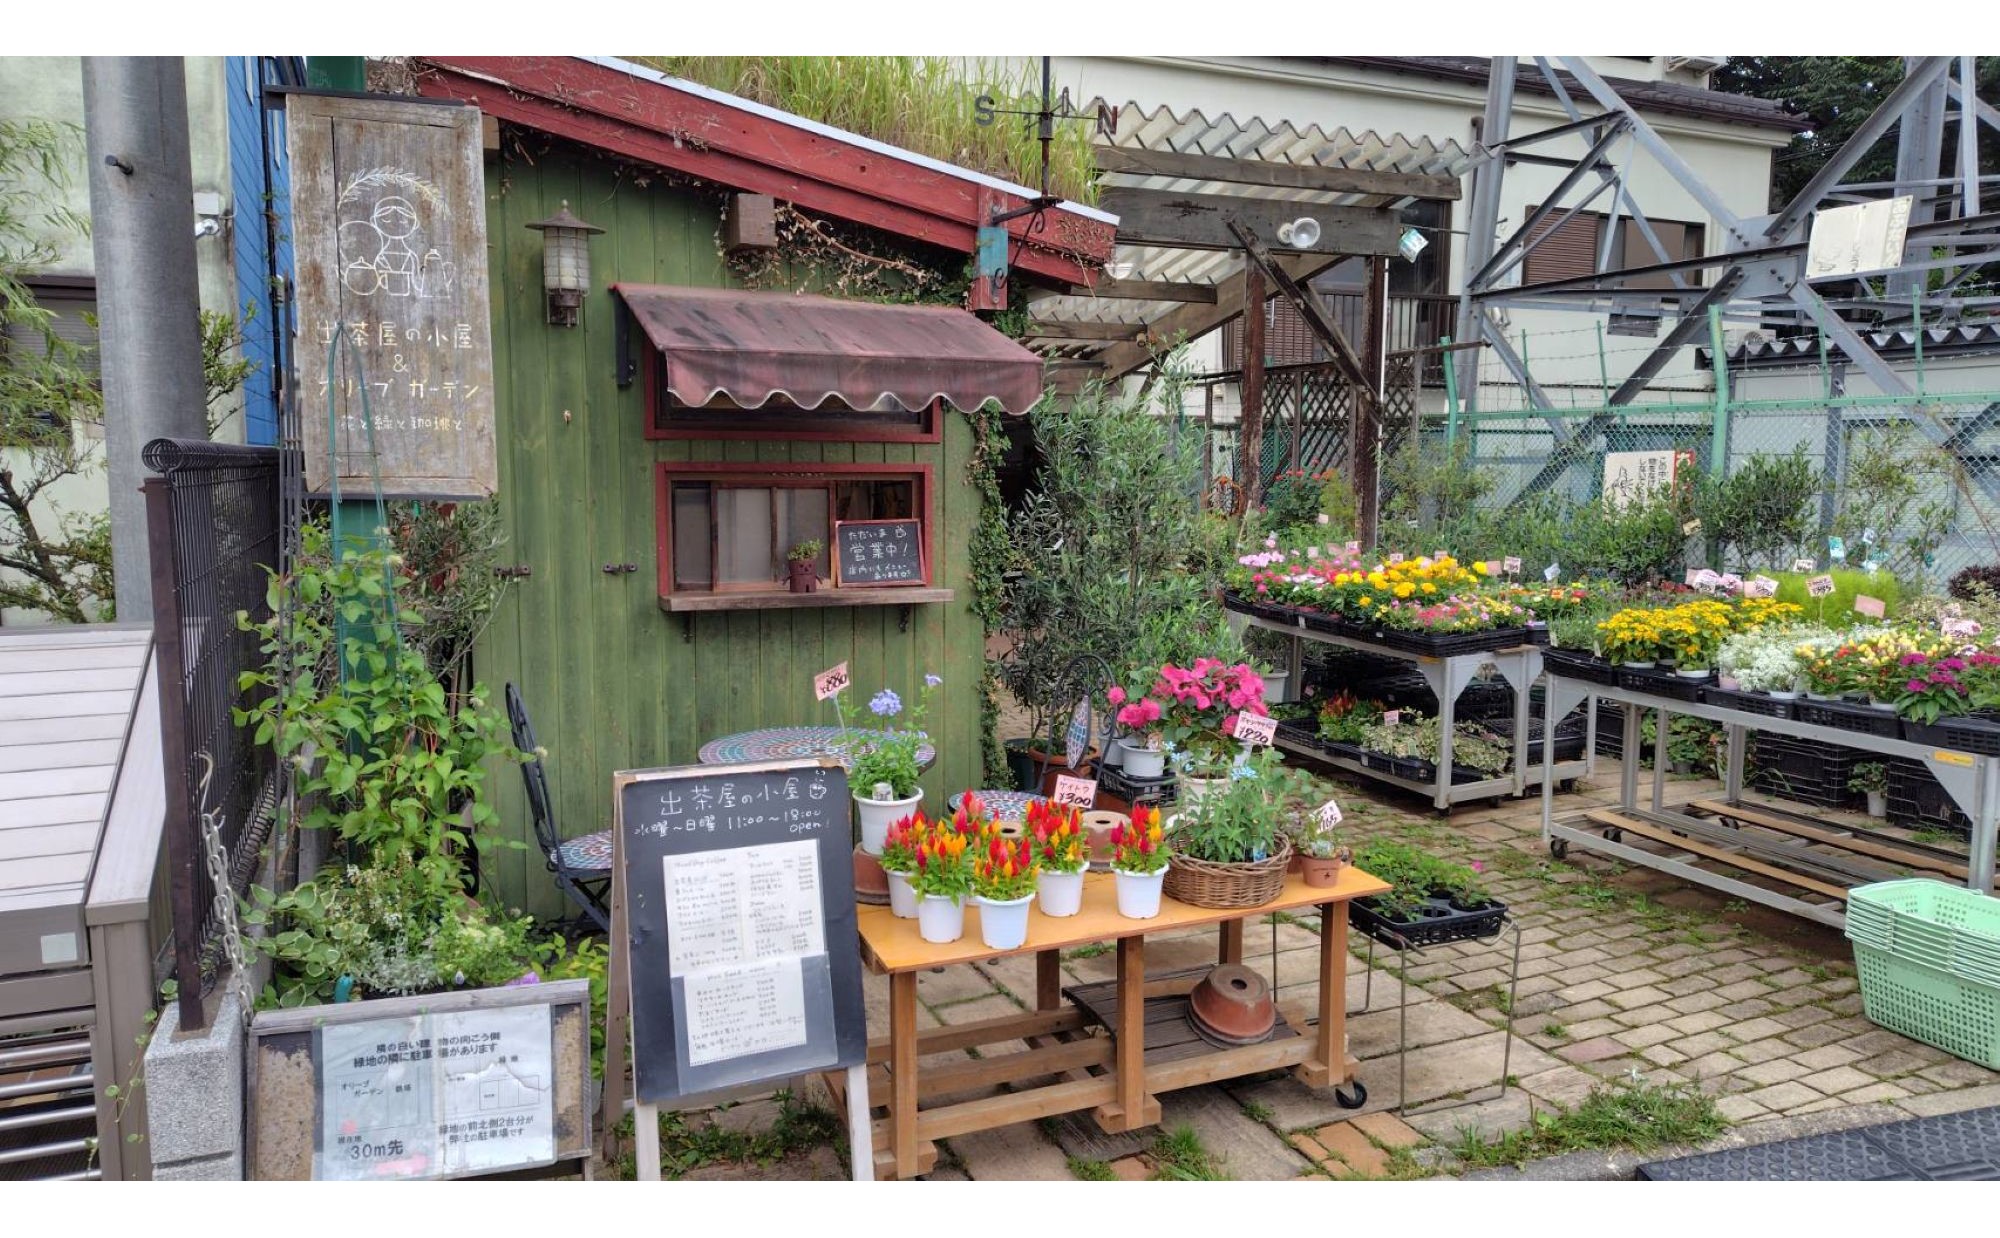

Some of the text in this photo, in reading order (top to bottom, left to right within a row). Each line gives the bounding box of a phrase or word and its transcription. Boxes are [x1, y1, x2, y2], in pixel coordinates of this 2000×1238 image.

[974, 96, 1118, 135] S N
[392, 353, 409, 373] &
[661, 777, 800, 815] 出茶屋の小屋
